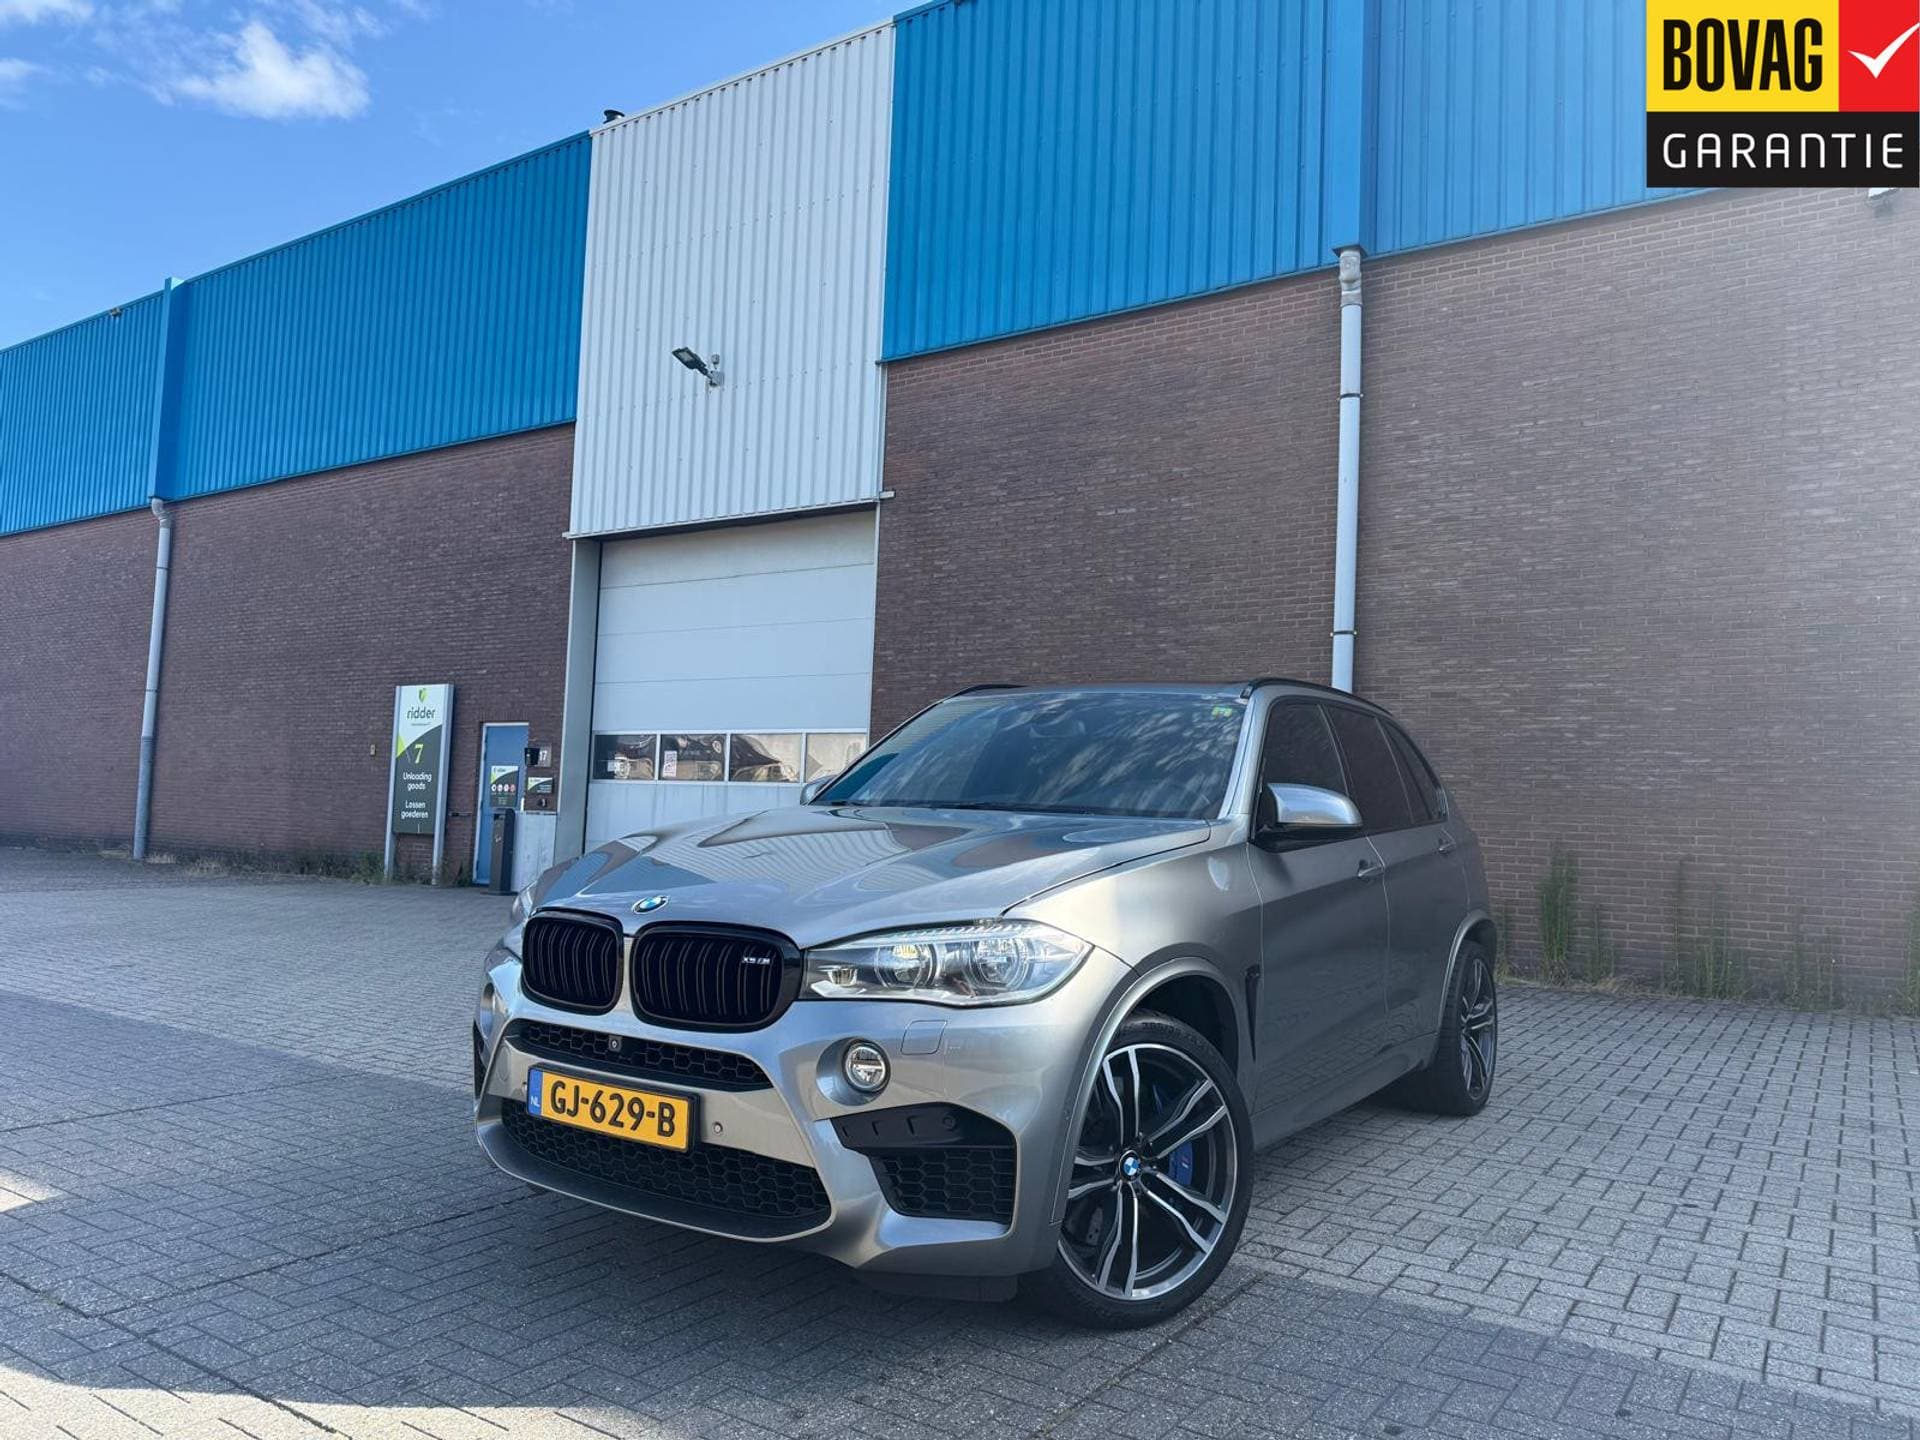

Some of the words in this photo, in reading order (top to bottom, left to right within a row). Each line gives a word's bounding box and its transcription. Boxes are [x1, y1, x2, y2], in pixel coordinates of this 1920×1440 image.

[406, 706, 436, 719] ridder
[414, 743, 424, 764] 7
[403, 771, 432, 782] Unloading
[407, 782, 426, 791] goods
[405, 799, 426, 809] Lossen
[400, 810, 429, 819] goederen
[550, 1080, 675, 1138] GJ-629-B
